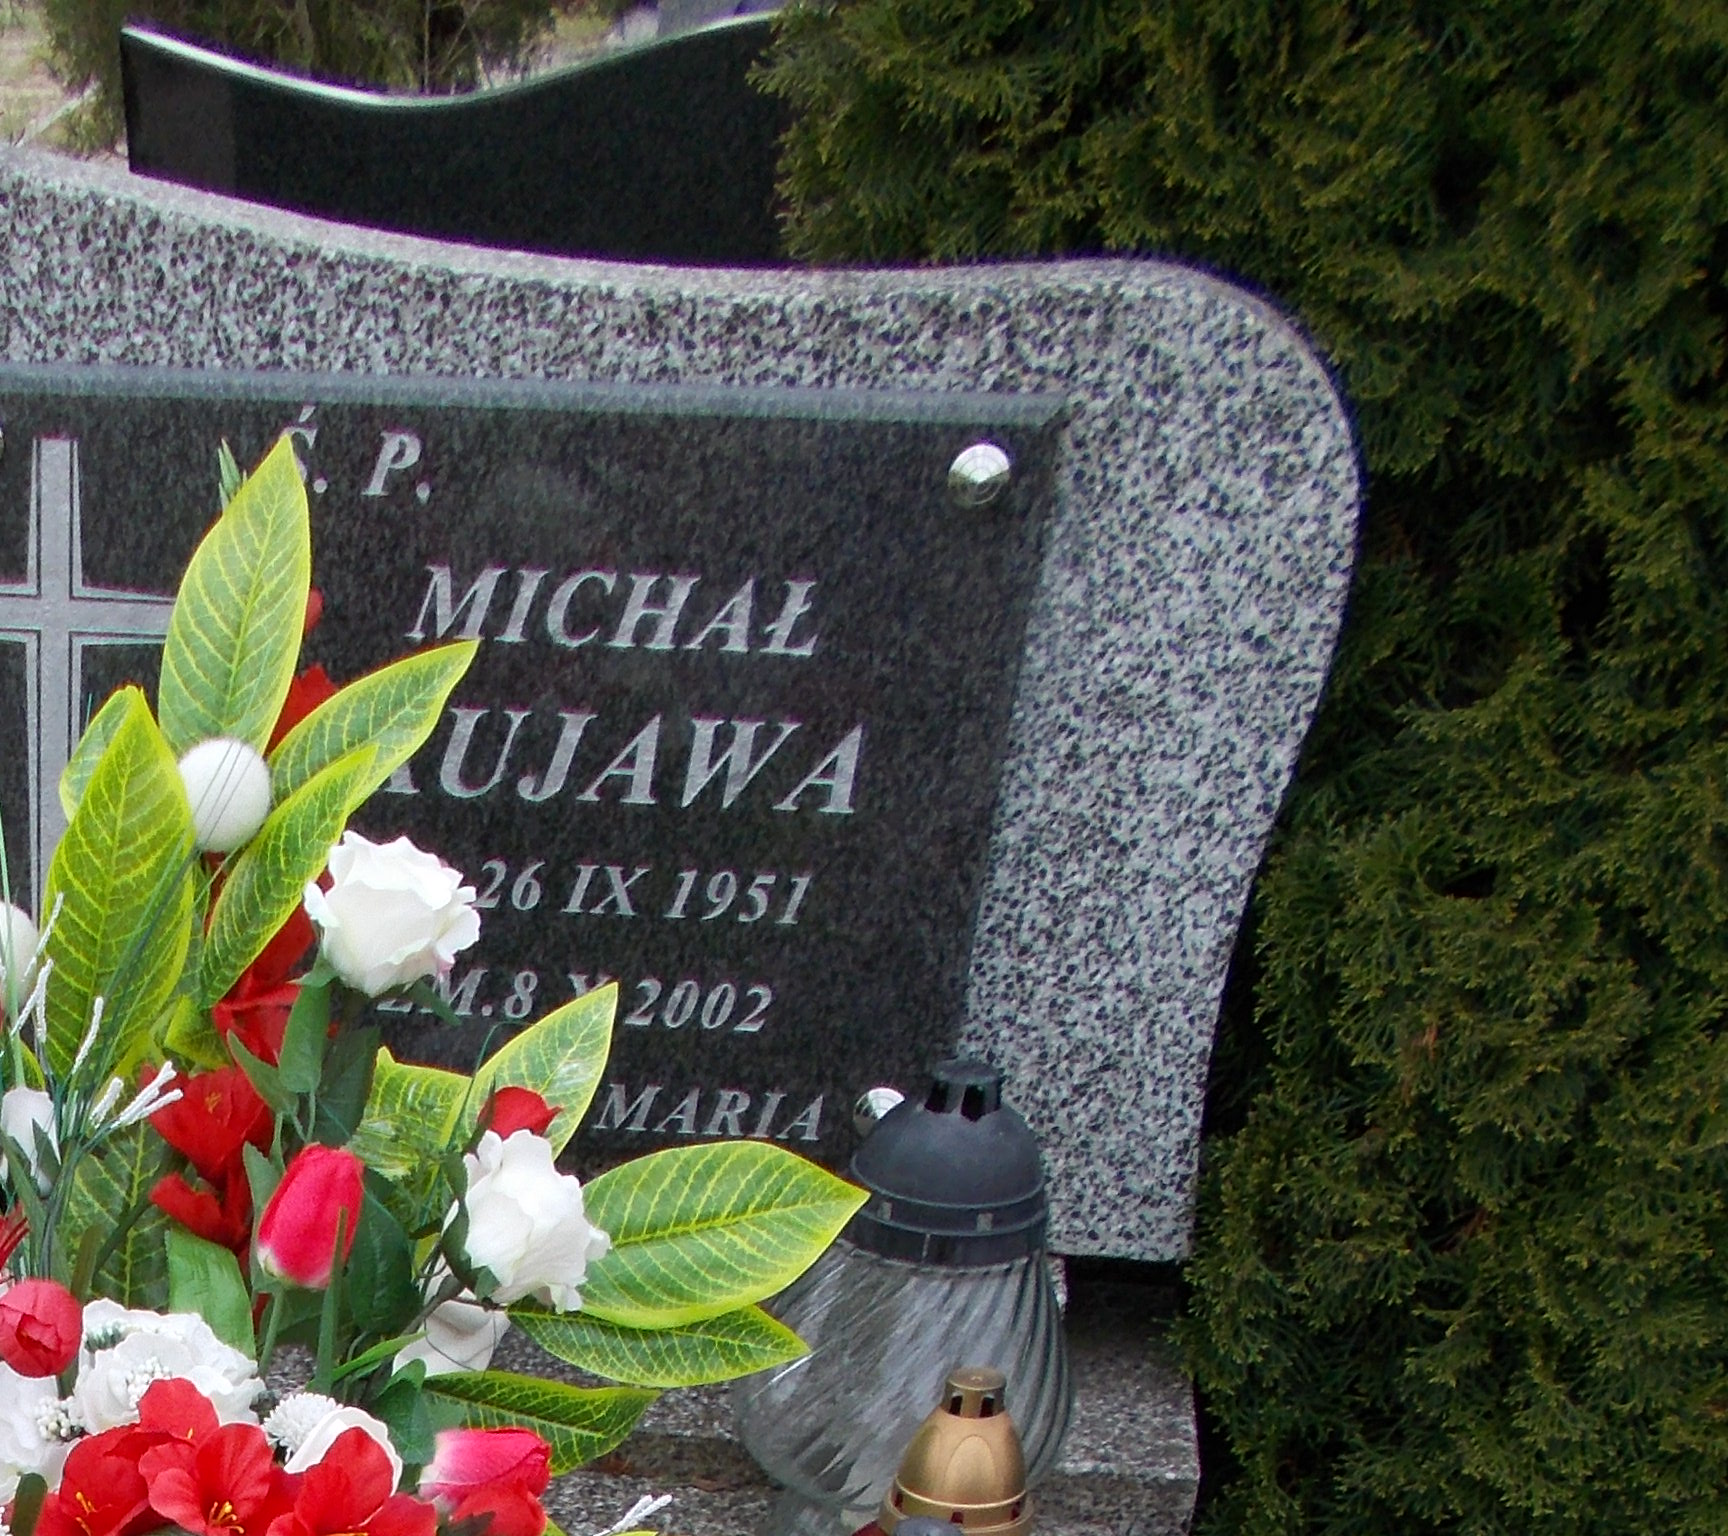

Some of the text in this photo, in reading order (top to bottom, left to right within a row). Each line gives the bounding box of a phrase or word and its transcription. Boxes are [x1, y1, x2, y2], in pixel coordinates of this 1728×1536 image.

[361, 430, 430, 504] P.
[404, 563, 818, 656] MICHAŁ
[383, 706, 864, 815] UJAWA
[474, 858, 812, 926] 26 IX 1951
[623, 976, 774, 1034] 2002
[593, 1082, 825, 1142] MARIA
